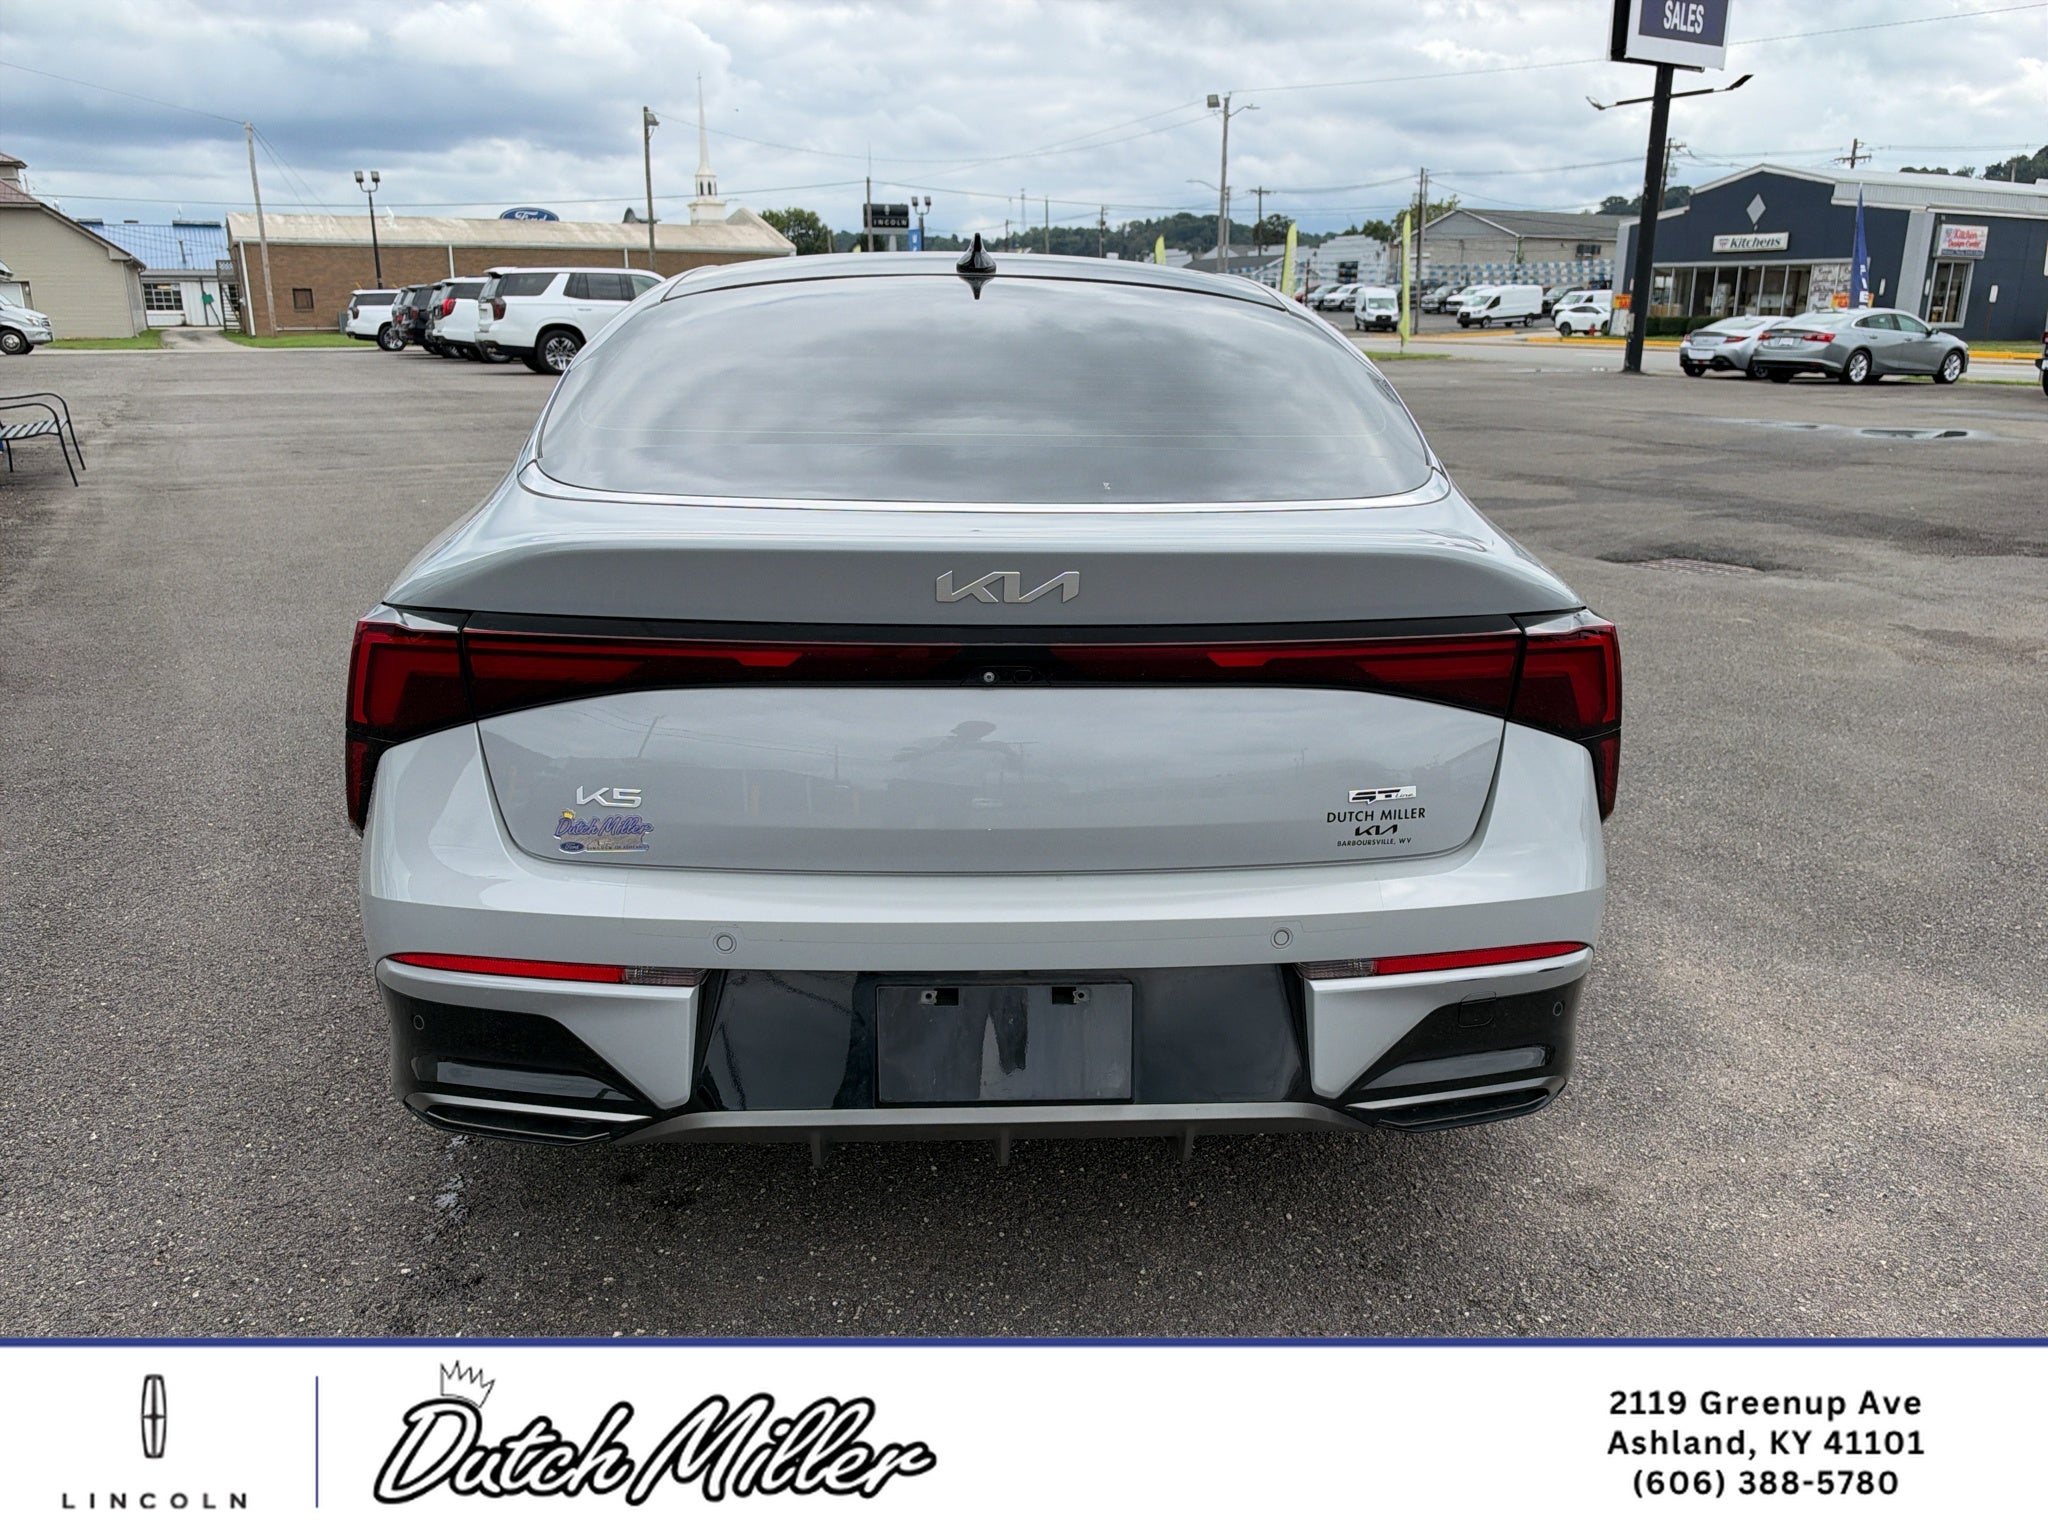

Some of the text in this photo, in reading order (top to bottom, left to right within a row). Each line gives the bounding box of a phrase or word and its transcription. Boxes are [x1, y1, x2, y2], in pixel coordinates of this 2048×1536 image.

[1663, 0, 1704, 34] SALES
[1730, 237, 1781, 248] Kitchens
[936, 570, 1080, 603] KIA
[576, 785, 642, 808] K5
[1327, 807, 1426, 823] DUTCH MILLER
[555, 815, 654, 836] Dutch Miller
[1354, 824, 1398, 836] KIA
[1337, 838, 1396, 847] BARBOURSVILLE,
